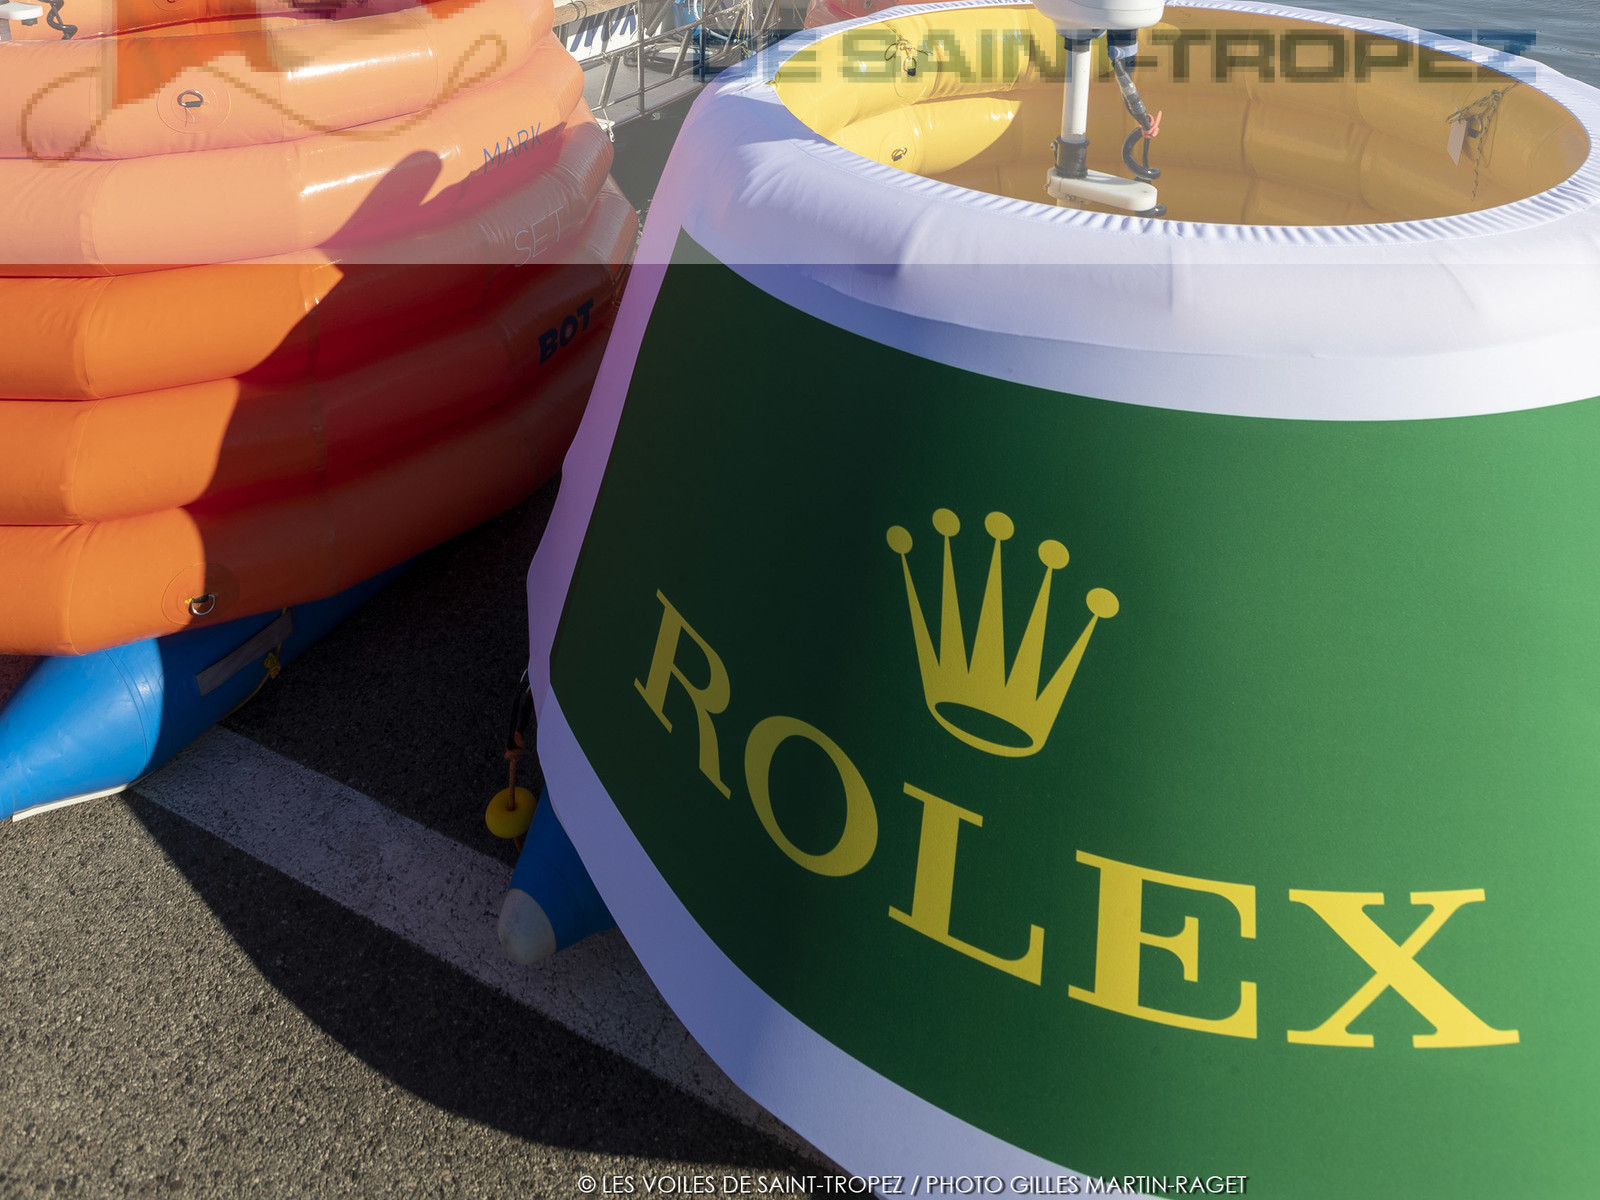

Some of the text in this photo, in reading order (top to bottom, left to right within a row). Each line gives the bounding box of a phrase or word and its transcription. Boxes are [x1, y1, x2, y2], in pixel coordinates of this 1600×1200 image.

[483, 121, 541, 174] MARK
[514, 206, 564, 267] SET
[538, 298, 594, 366] BOT
[633, 587, 1521, 1049] ROLEX
